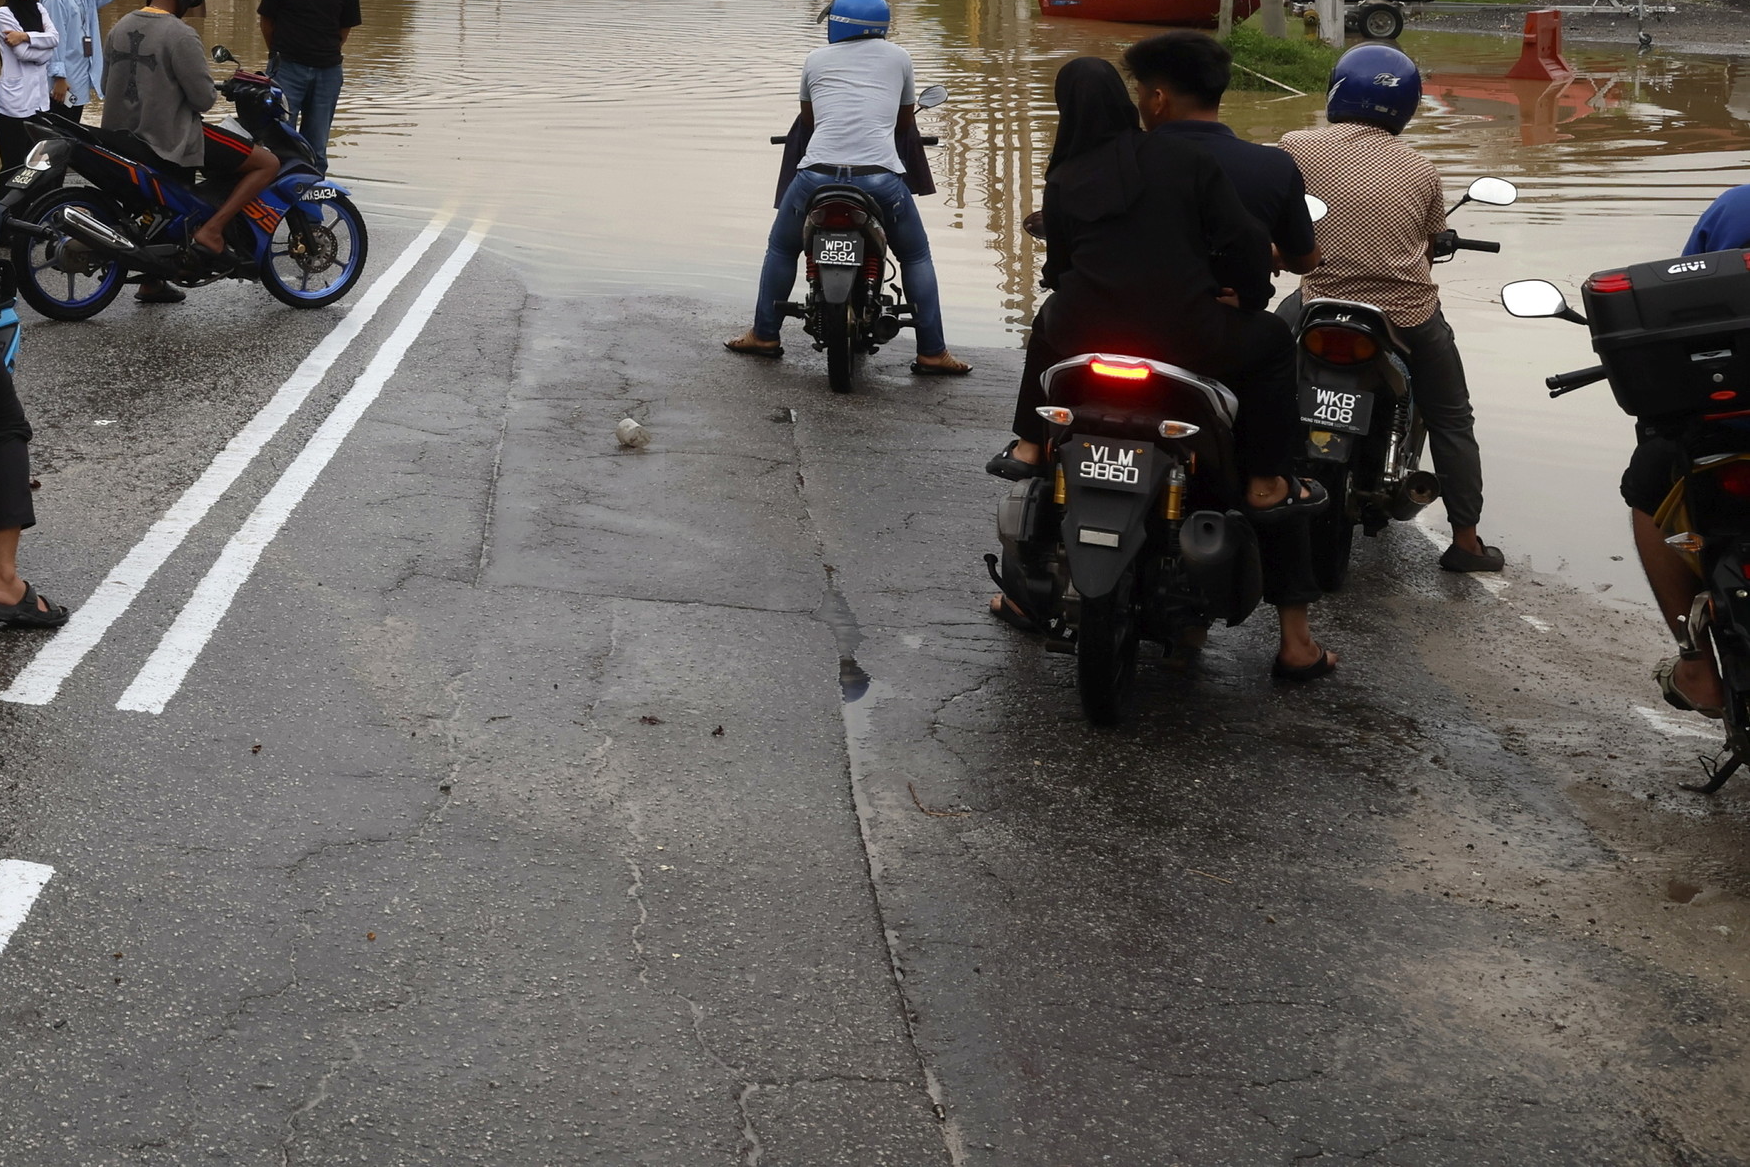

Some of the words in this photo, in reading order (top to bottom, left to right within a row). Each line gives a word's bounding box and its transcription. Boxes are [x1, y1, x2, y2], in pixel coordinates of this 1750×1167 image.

[820, 250, 856, 262] 6584
[825, 240, 853, 252] WPD
[1667, 260, 1707, 274] GIVI
[1316, 388, 1356, 409] WKB
[1313, 404, 1353, 424] 408
[1090, 445, 1134, 467] VLM
[1079, 461, 1139, 484] 9860
